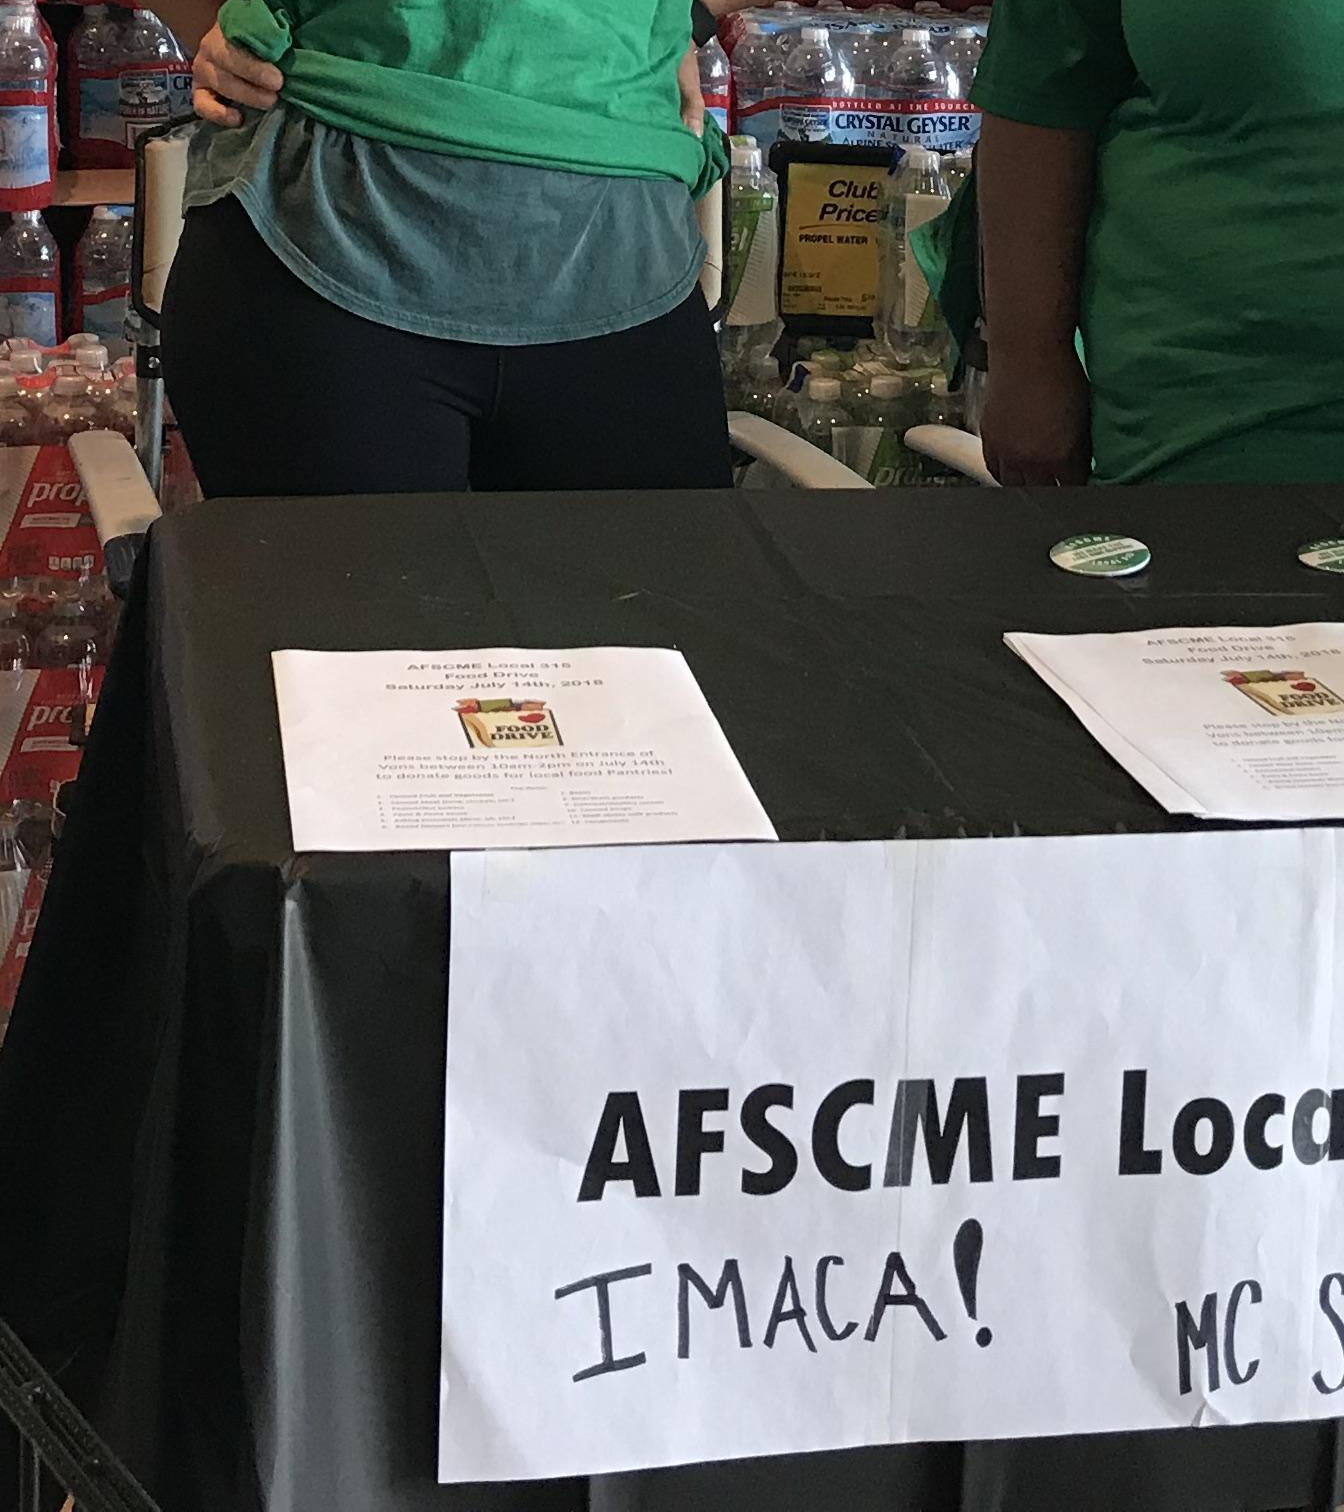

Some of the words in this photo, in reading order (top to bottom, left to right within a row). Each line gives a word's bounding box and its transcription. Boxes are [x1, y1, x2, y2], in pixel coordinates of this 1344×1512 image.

[835, 113, 904, 133] CRYSTAL
[907, 115, 971, 133] GEYSER
[828, 179, 879, 198] Club
[799, 234, 834, 244] PROPEL
[836, 235, 868, 245] WATER
[26, 482, 93, 511] prop
[490, 731, 555, 742] DRIVE
[495, 724, 549, 734] FOOD
[576, 1072, 1065, 1202] AFSCME
[1174, 1278, 1262, 1396] MC
